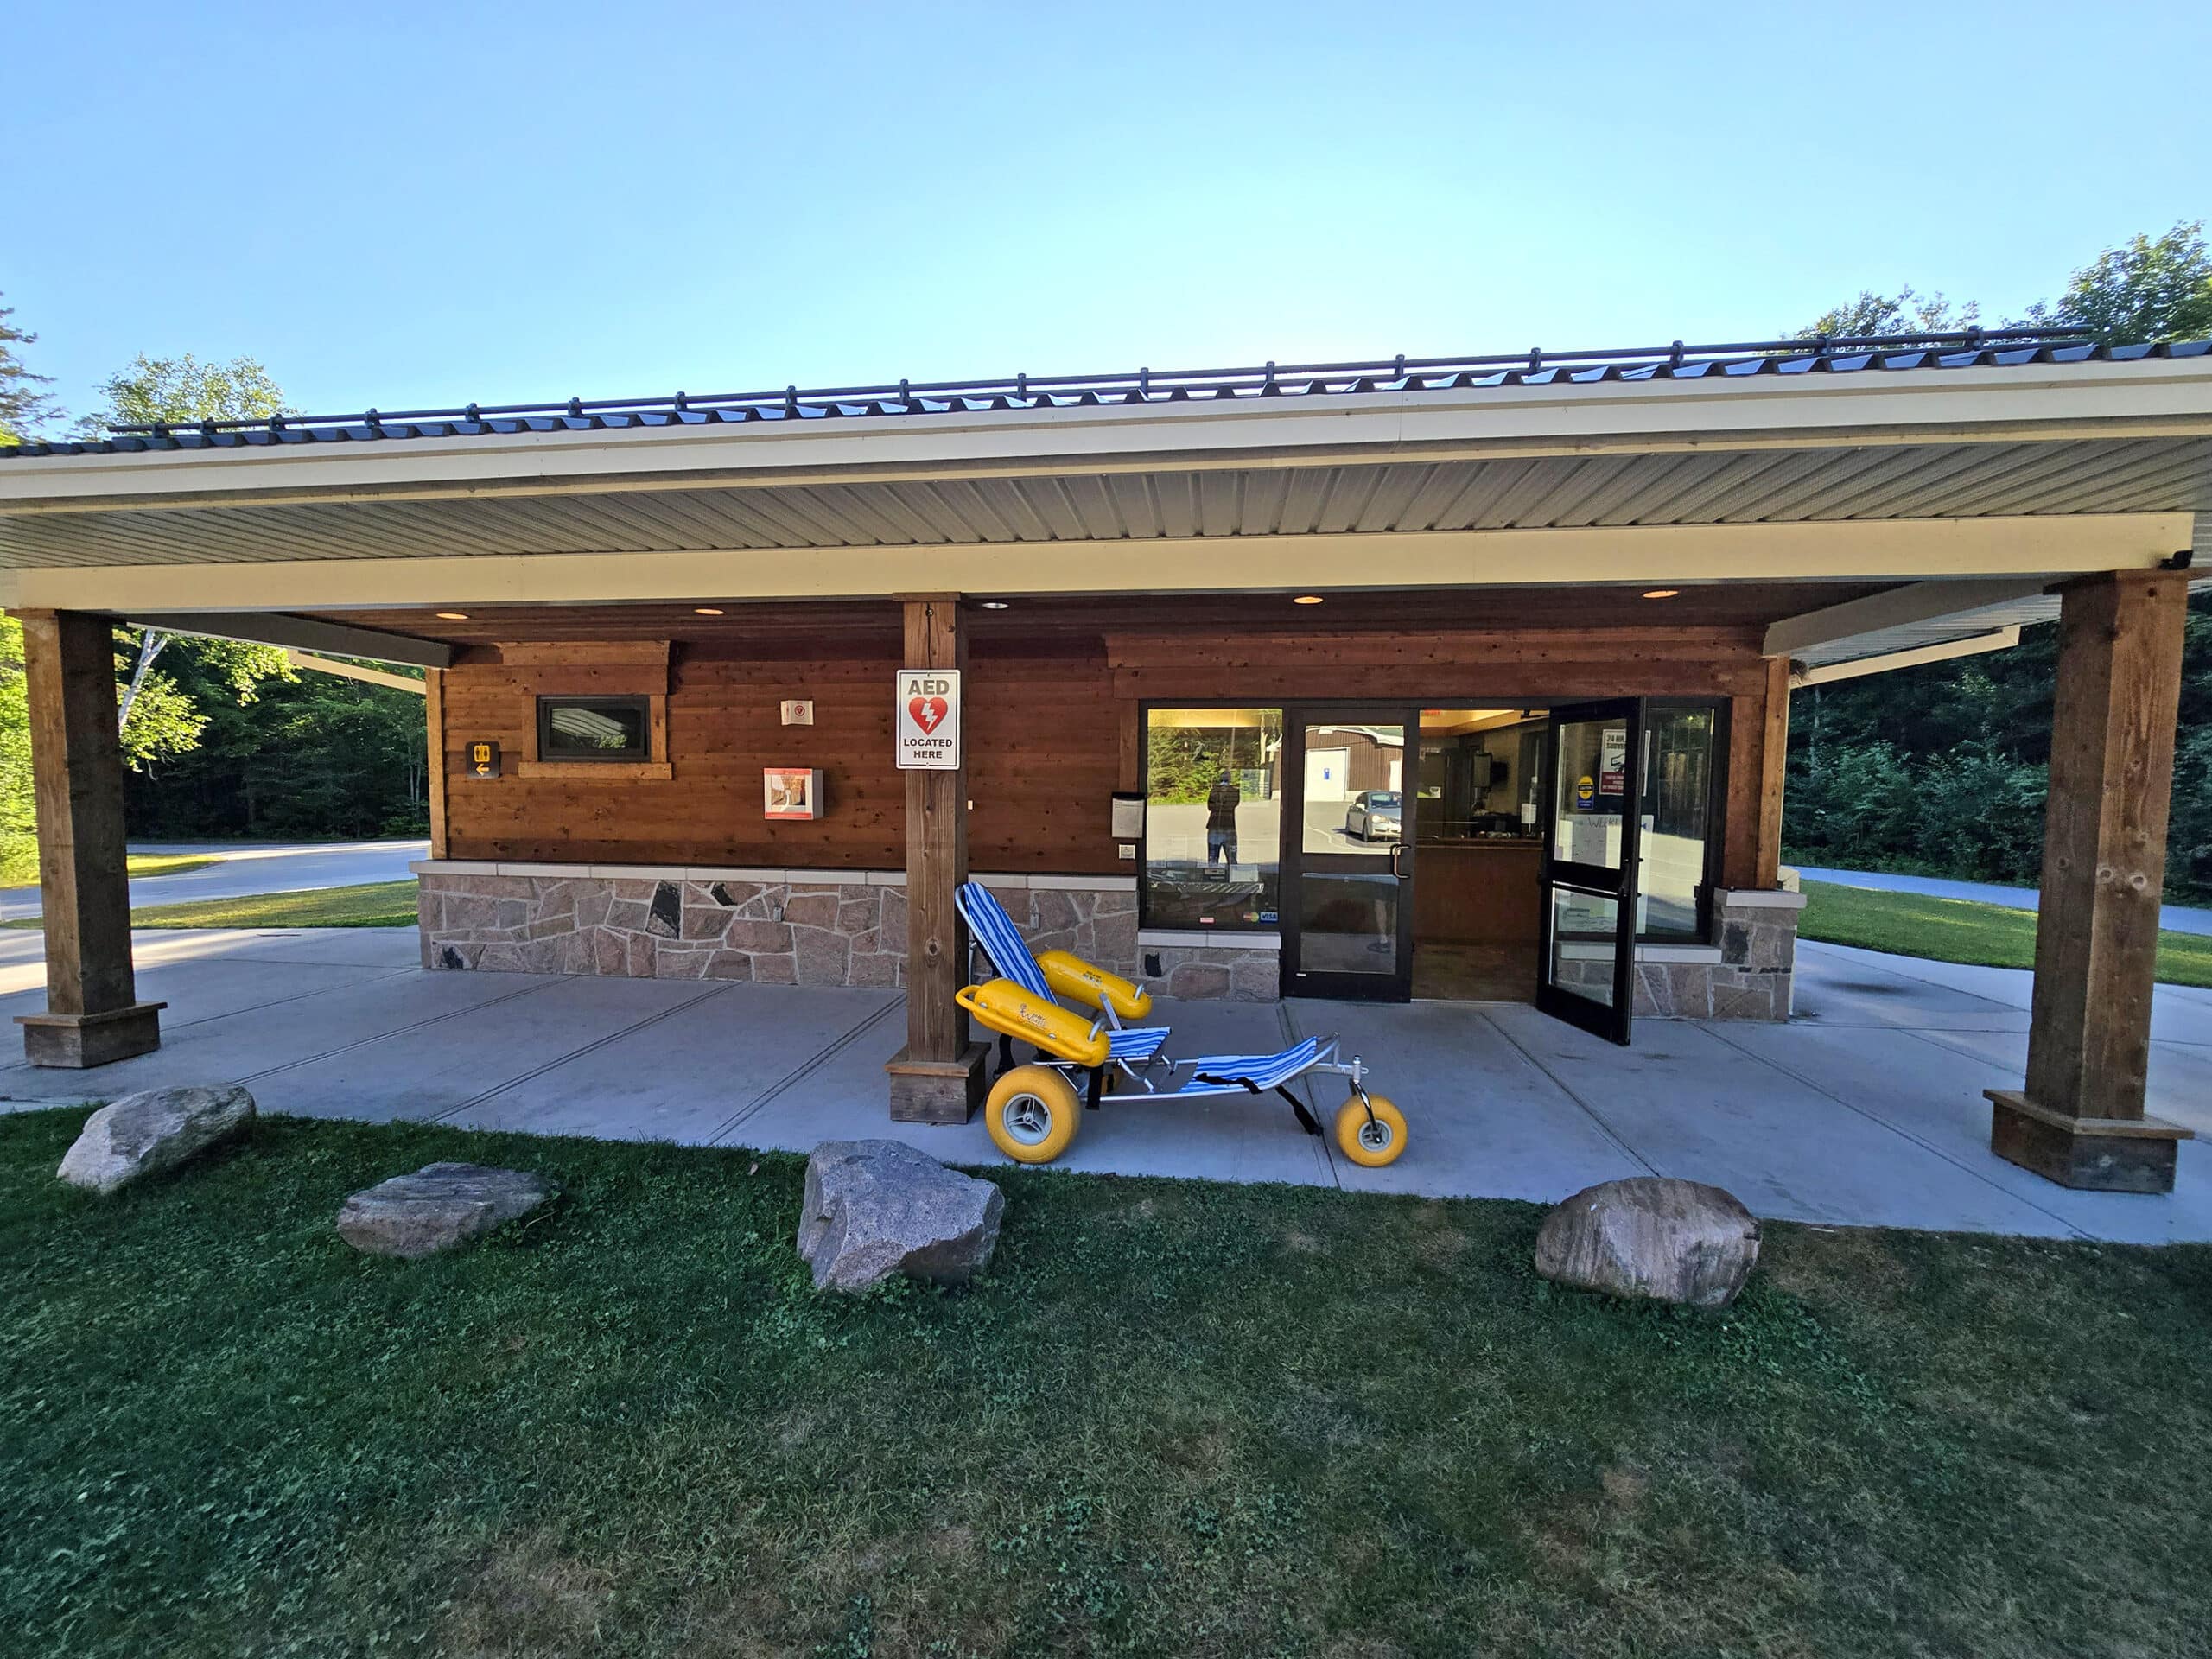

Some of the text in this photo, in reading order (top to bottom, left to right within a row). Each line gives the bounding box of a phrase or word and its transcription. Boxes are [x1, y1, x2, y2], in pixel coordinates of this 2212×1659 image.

[908, 680, 950, 695] AED
[904, 738, 953, 747] LOCATED
[913, 750, 943, 759] HERE
